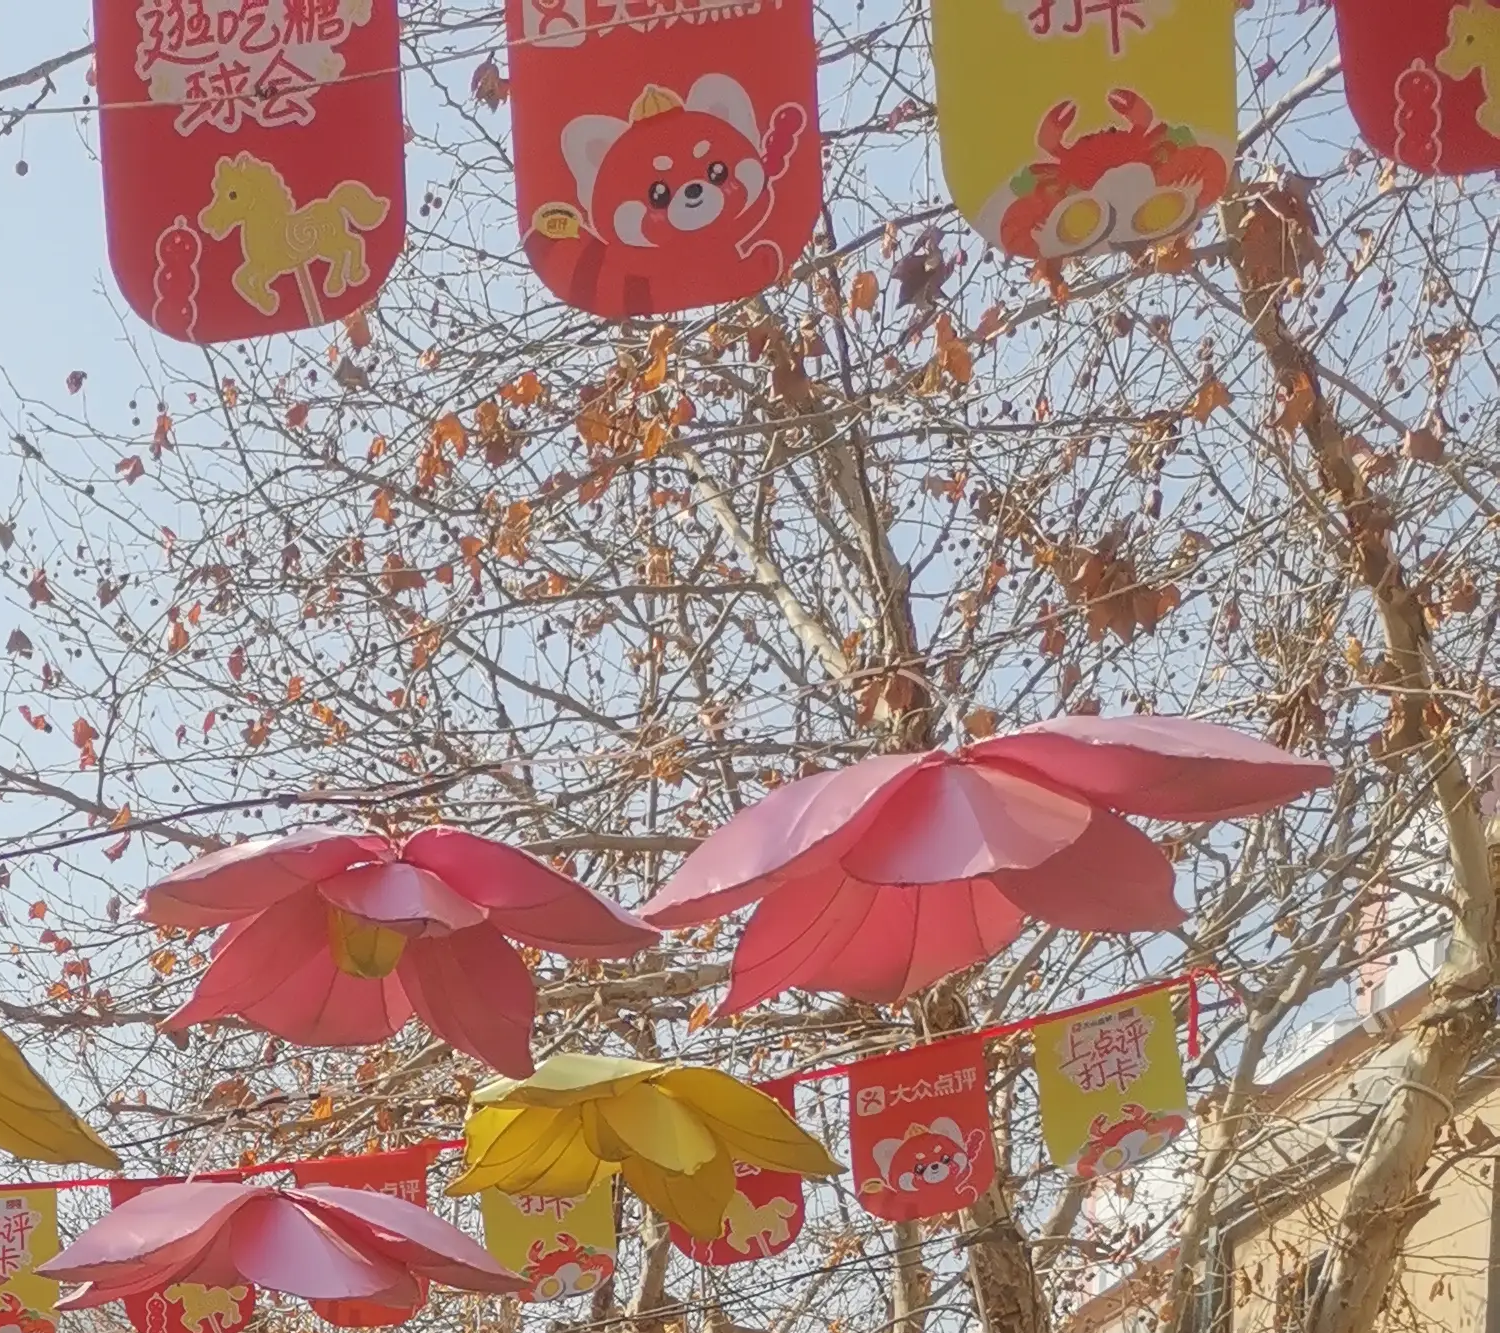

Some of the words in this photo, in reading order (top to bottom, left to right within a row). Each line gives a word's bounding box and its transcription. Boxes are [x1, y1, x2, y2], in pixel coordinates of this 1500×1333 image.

[182, 48, 317, 129] 球会
[1059, 1018, 1147, 1068] 上点评
[891, 1067, 977, 1106] 大众点评
[1077, 1058, 1144, 1092] 打卡
